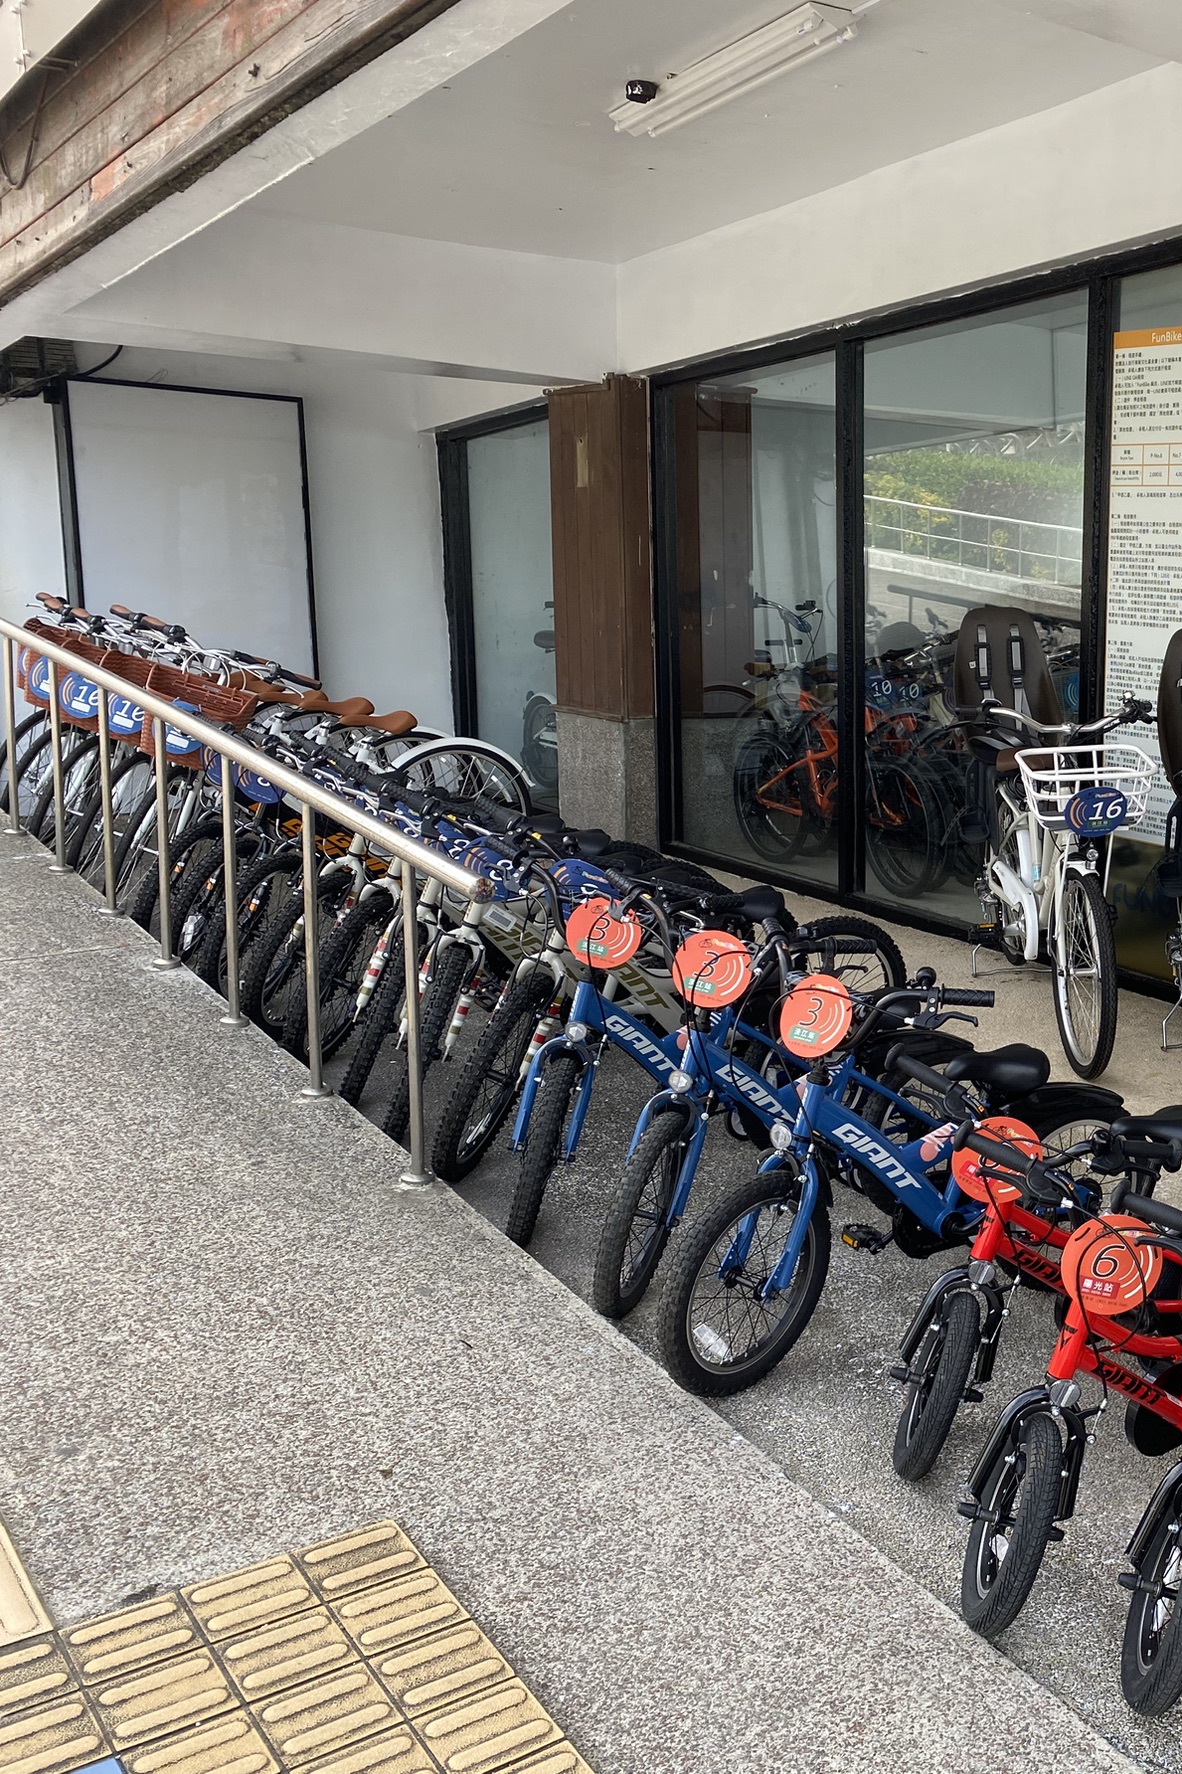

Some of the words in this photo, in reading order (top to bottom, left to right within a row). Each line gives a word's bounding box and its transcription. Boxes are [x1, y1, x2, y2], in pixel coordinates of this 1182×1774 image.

[1088, 797, 1124, 820] 16
[585, 915, 611, 943] 3
[692, 950, 720, 979] 3
[798, 995, 824, 1028] 3
[605, 1014, 679, 1073] GIANT
[715, 1064, 796, 1126] GIANT
[832, 1123, 921, 1189] GIANT
[1091, 1243, 1127, 1279] 6
[1091, 1359, 1166, 1405] GIANT
